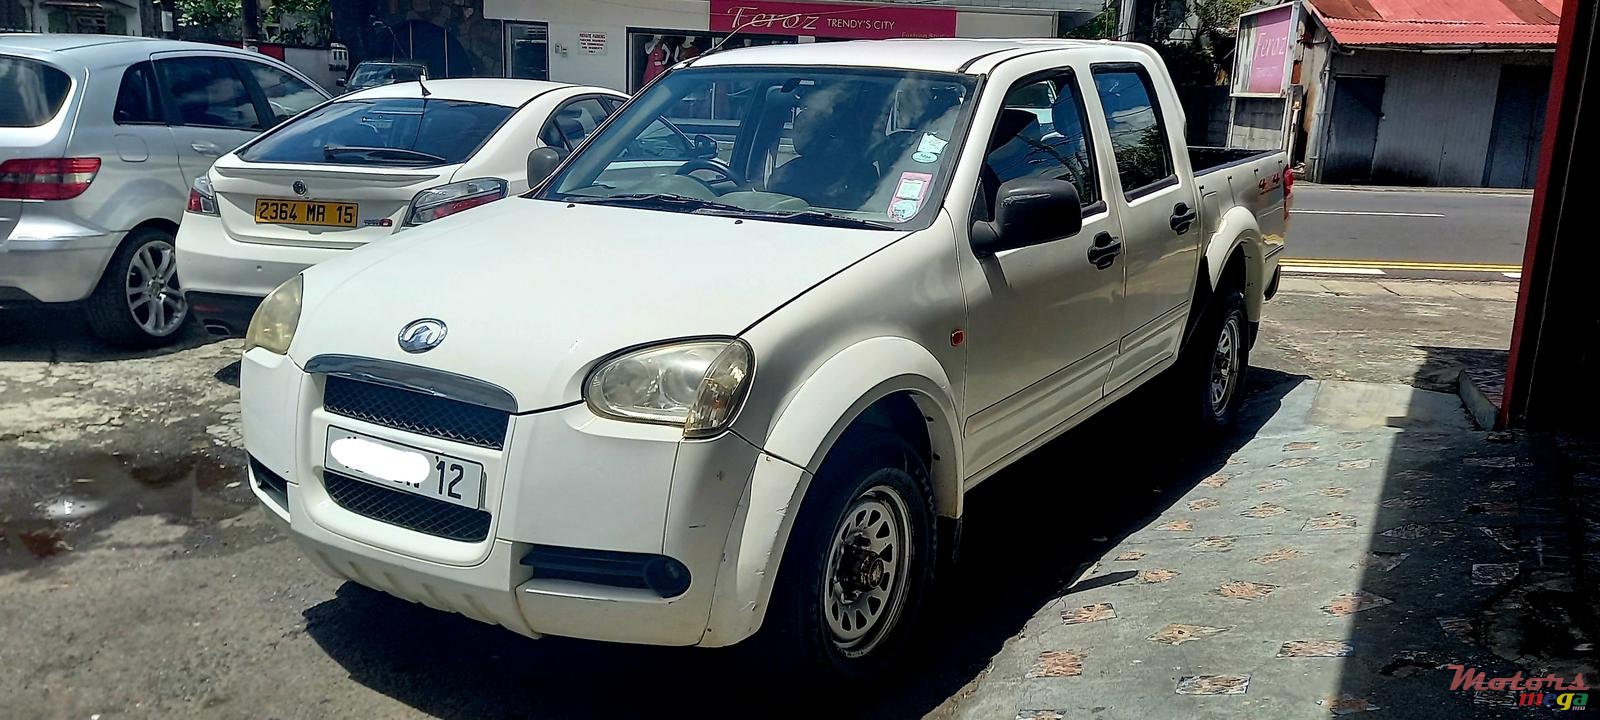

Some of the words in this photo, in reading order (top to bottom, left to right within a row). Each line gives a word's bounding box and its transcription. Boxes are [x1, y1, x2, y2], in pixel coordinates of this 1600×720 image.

[728, 6, 819, 30] Feroz
[827, 18, 872, 29] TRENDY'S
[873, 20, 895, 30] CITY
[260, 202, 297, 221] 2364
[306, 204, 326, 222] MR
[336, 206, 354, 224] 15
